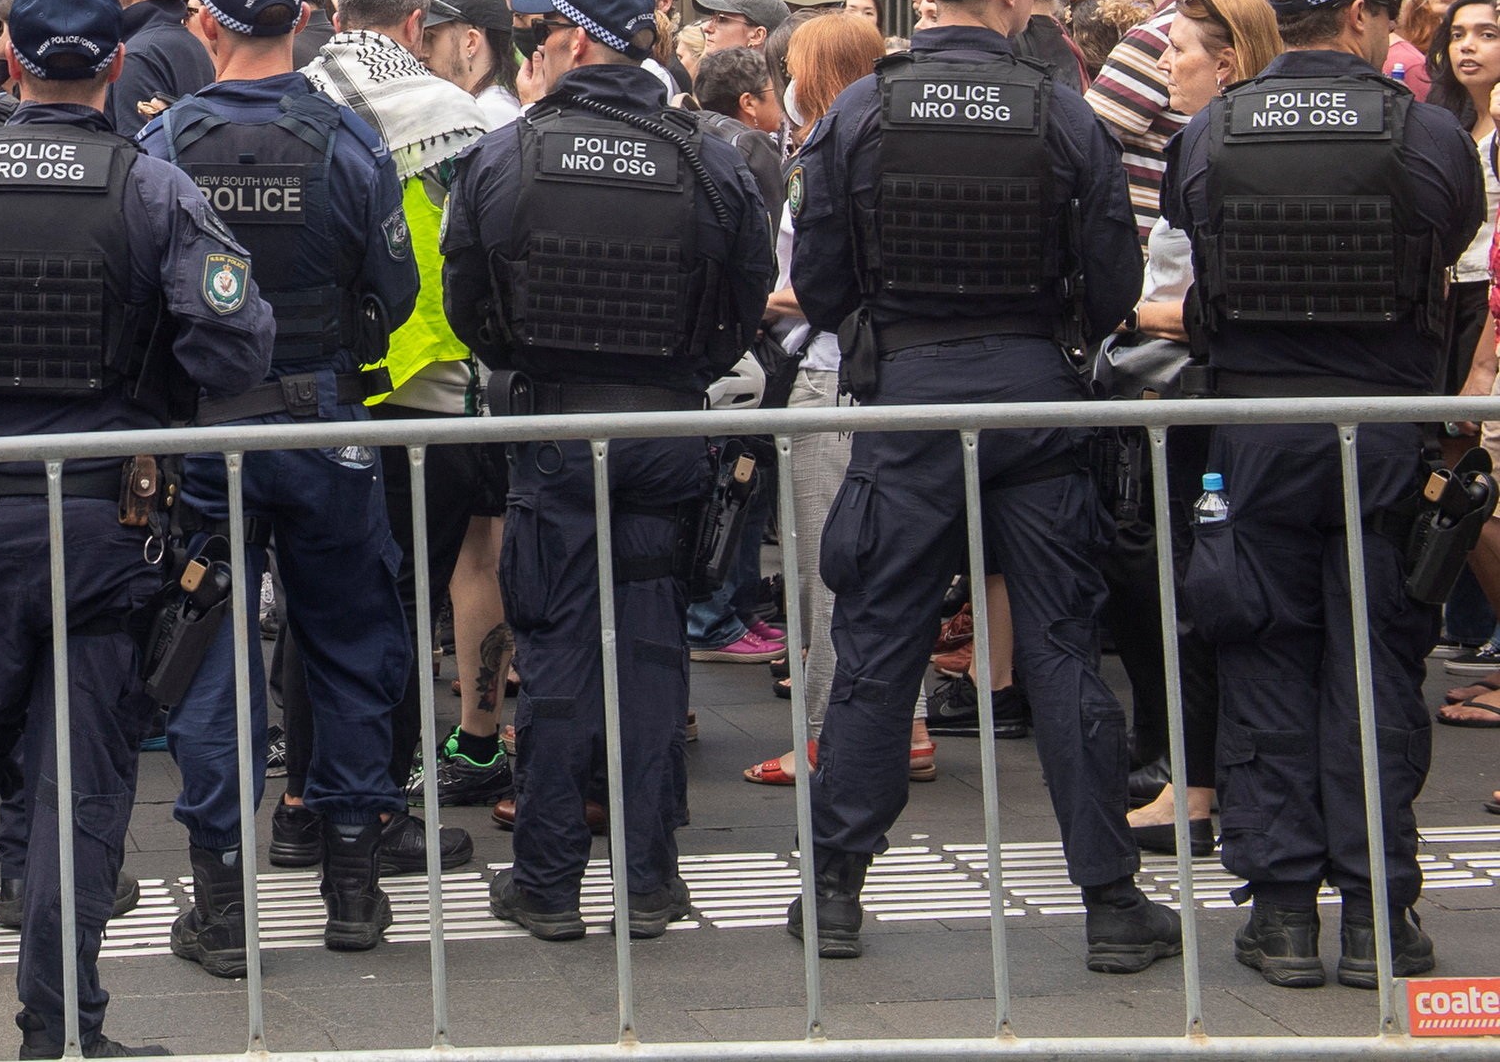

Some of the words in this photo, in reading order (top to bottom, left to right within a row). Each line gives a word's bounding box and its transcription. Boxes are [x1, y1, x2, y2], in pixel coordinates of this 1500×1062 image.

[36, 39, 50, 56] NSW
[51, 35, 79, 44] POLICE
[78, 37, 101, 56] FORCE
[923, 83, 1000, 103] POLICE
[1265, 92, 1347, 109] POLICE
[910, 101, 956, 118] NRO
[964, 104, 1011, 121] OSG
[1252, 109, 1300, 127] NRO
[1309, 109, 1358, 125] OSG
[574, 137, 647, 158] POLICE
[36, 162, 85, 180] OSG
[561, 153, 605, 171] NRO
[613, 158, 656, 176] OSG
[195, 176, 220, 185] NEW
[222, 176, 260, 186] SOUTH
[262, 176, 301, 187] WALES
